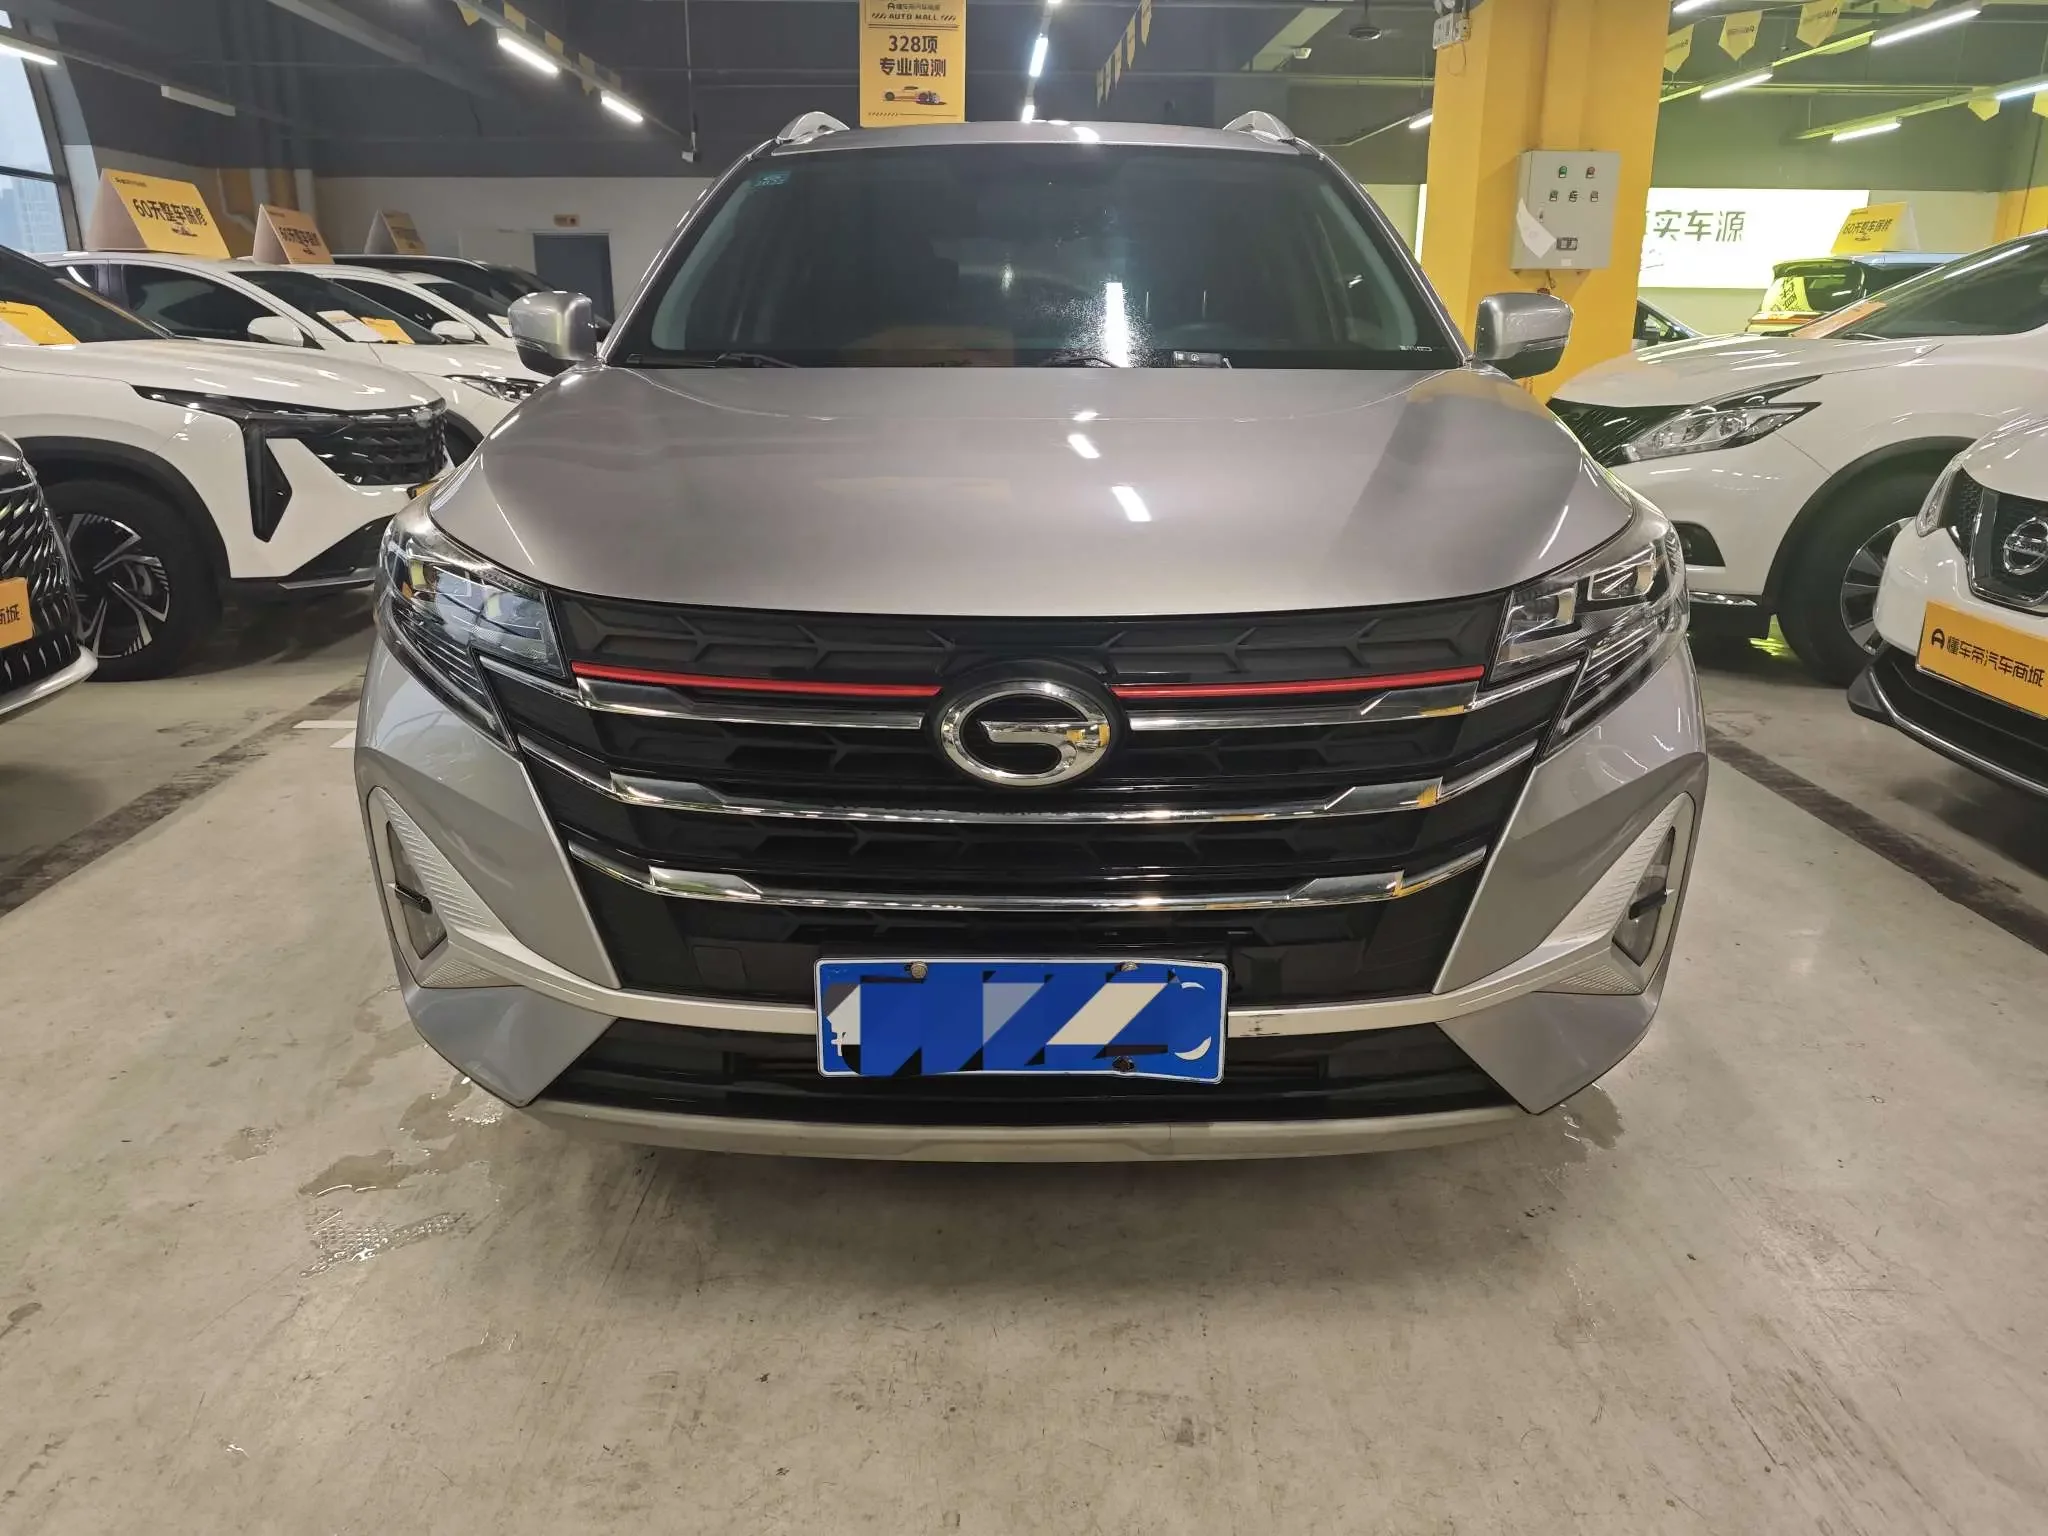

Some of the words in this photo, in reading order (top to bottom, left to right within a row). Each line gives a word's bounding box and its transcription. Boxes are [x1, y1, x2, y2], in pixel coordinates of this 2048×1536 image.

[915, 13, 937, 21] MALL
[888, 35, 938, 53] 328项
[880, 57, 946, 77] 专业检测
[1645, 209, 1746, 242] 实车源
